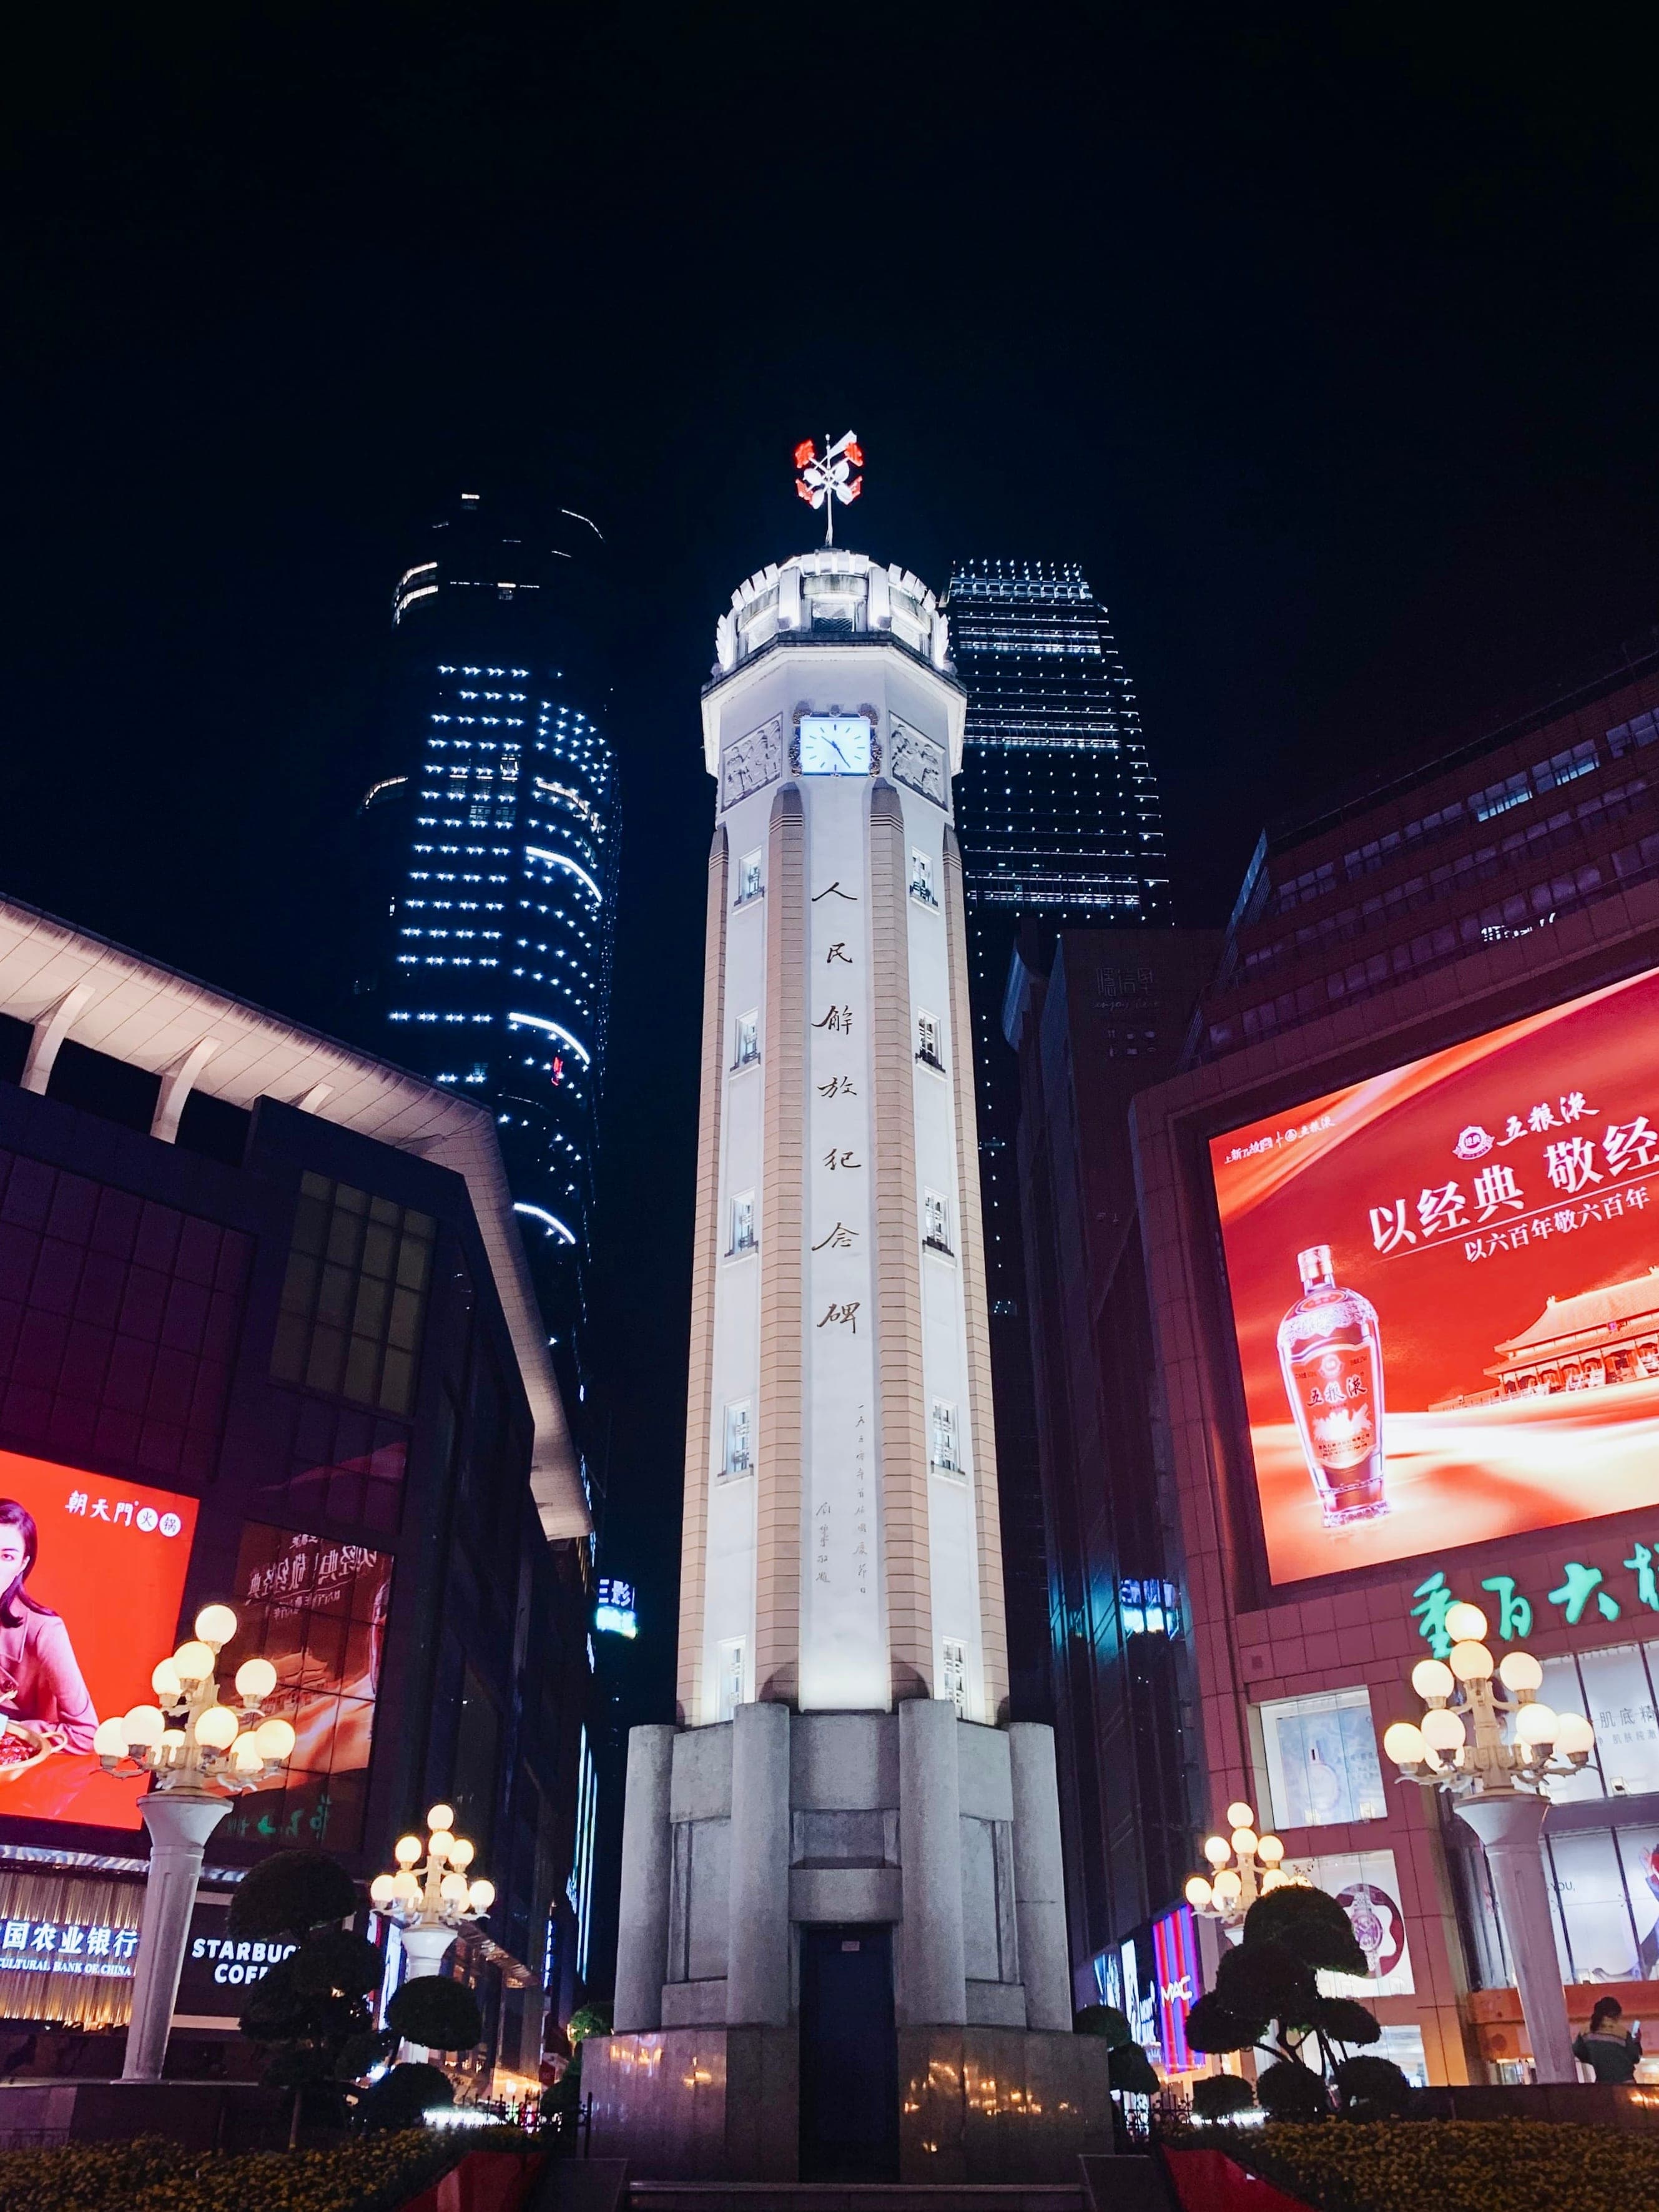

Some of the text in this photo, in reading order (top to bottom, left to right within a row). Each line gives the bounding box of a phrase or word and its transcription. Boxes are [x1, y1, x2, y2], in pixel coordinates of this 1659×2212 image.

[1496, 1091, 1600, 1146] 五粮液
[1369, 1115, 1659, 1254] 以经典 敬经
[1465, 1186, 1651, 1262] 以六百年敬六百年
[0, 1920, 138, 1958] 国农业银行
[192, 1938, 301, 1964] STARBUC
[52, 1960, 82, 1974] BANK
[84, 1963, 100, 1974] OF
[101, 1965, 131, 1976] CHINA
[1161, 1975, 1193, 2008] MAC
